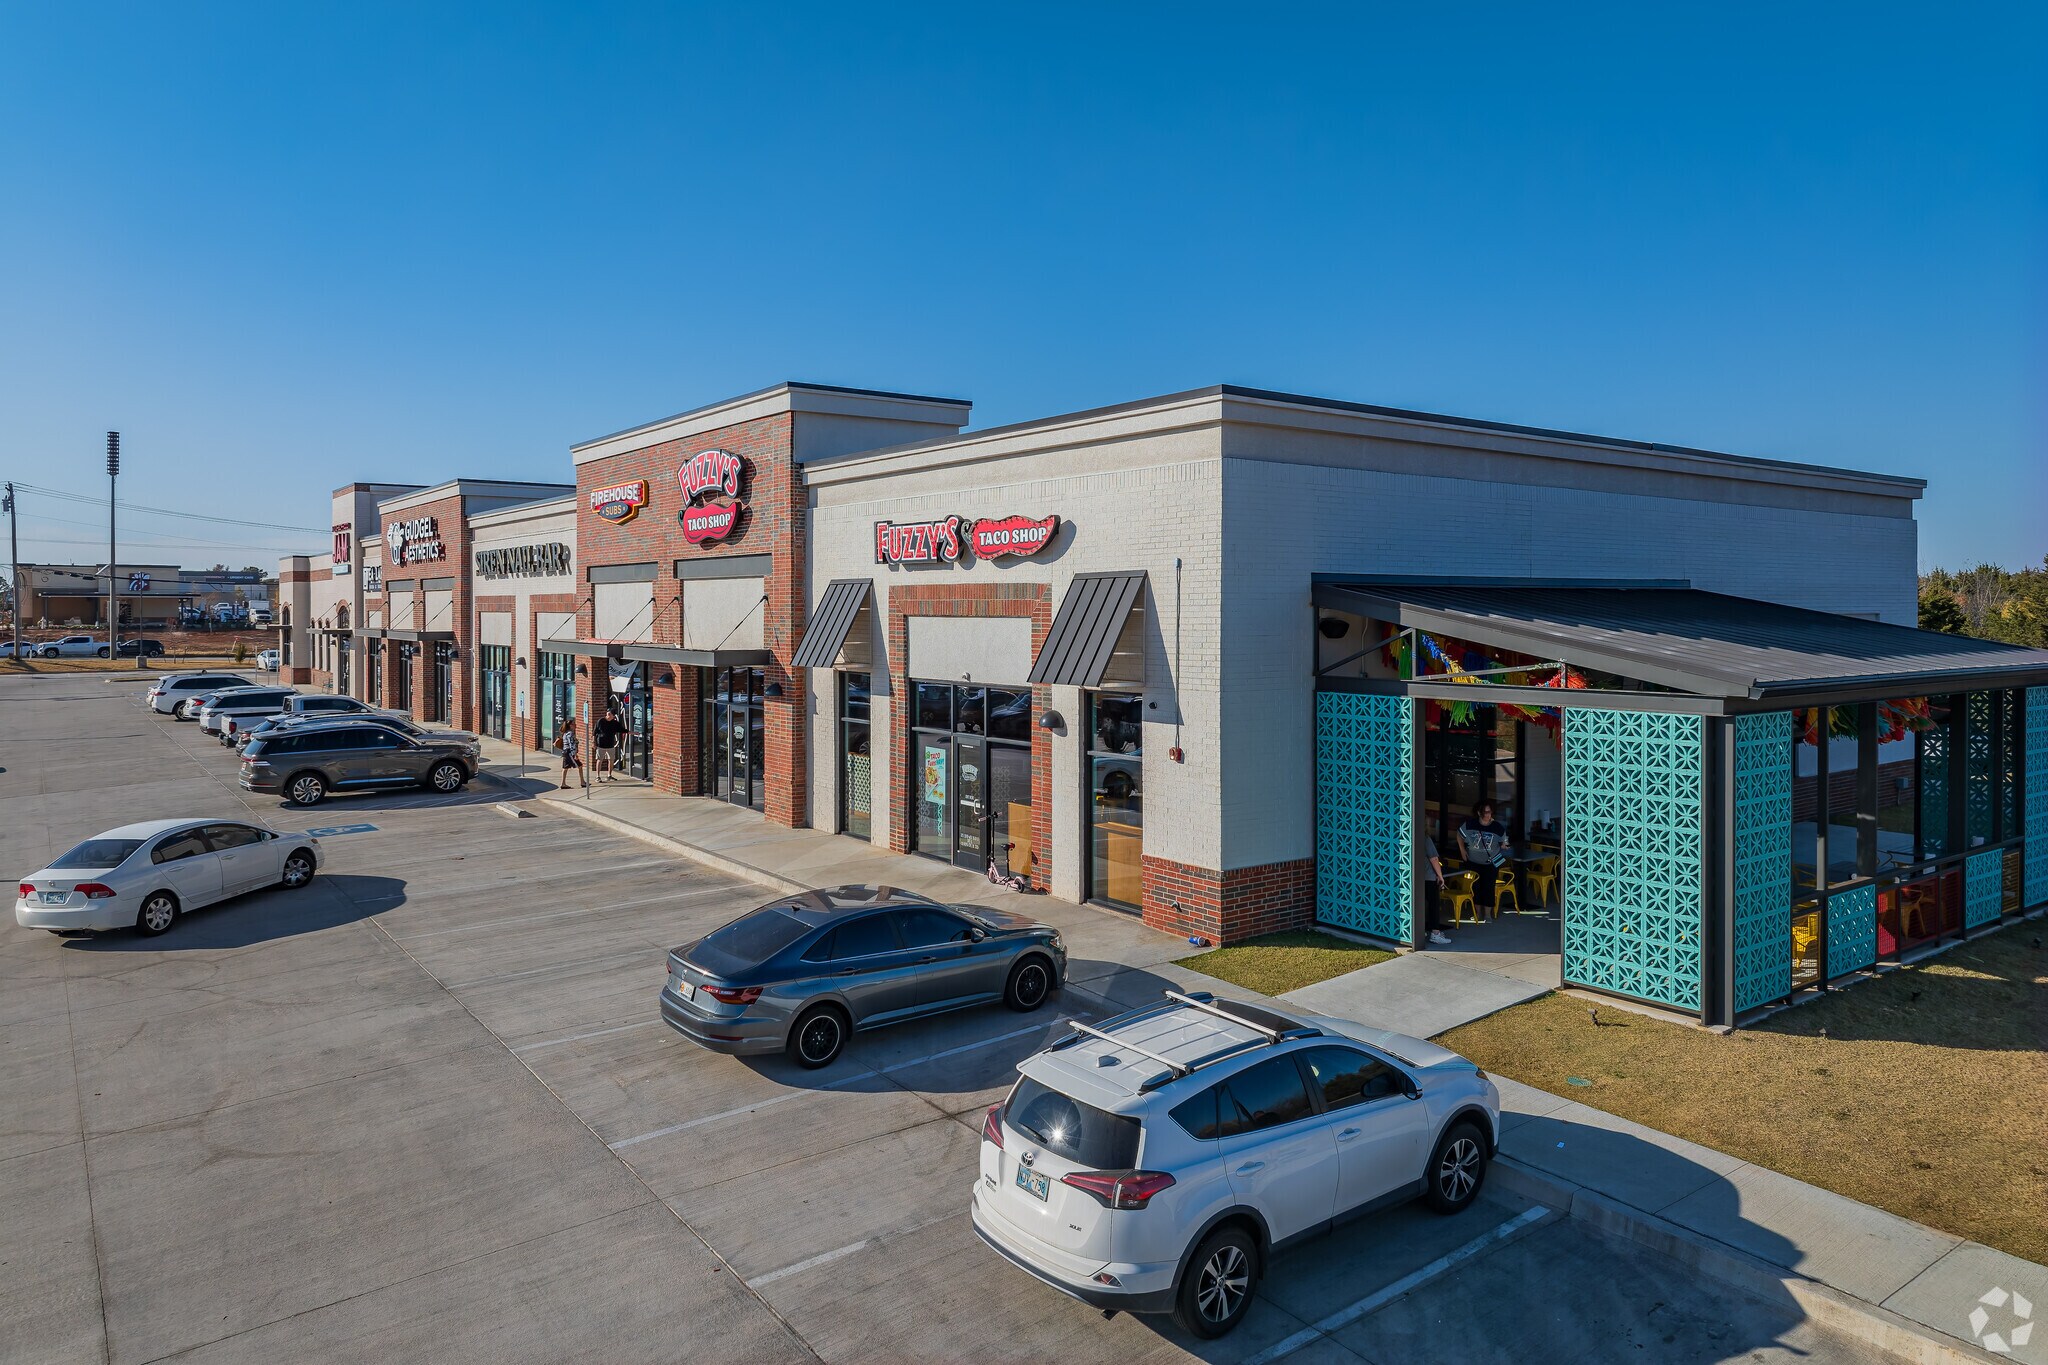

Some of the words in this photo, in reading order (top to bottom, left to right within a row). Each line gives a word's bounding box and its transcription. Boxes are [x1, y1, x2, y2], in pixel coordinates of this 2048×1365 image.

[677, 451, 741, 507] FUZZY'S
[590, 484, 638, 508] FIREHOUSE
[605, 504, 622, 516] SUBS
[688, 517, 708, 531] TACO
[708, 513, 730, 528] SHOP
[404, 517, 434, 541] GUDGEL
[876, 516, 959, 562] FUZZY'S
[979, 530, 1009, 547] TACO
[1012, 526, 1047, 544] SHOP
[405, 540, 439, 562] AESTHETICS
[475, 548, 506, 576] SIREN
[536, 542, 564, 573] BAR
